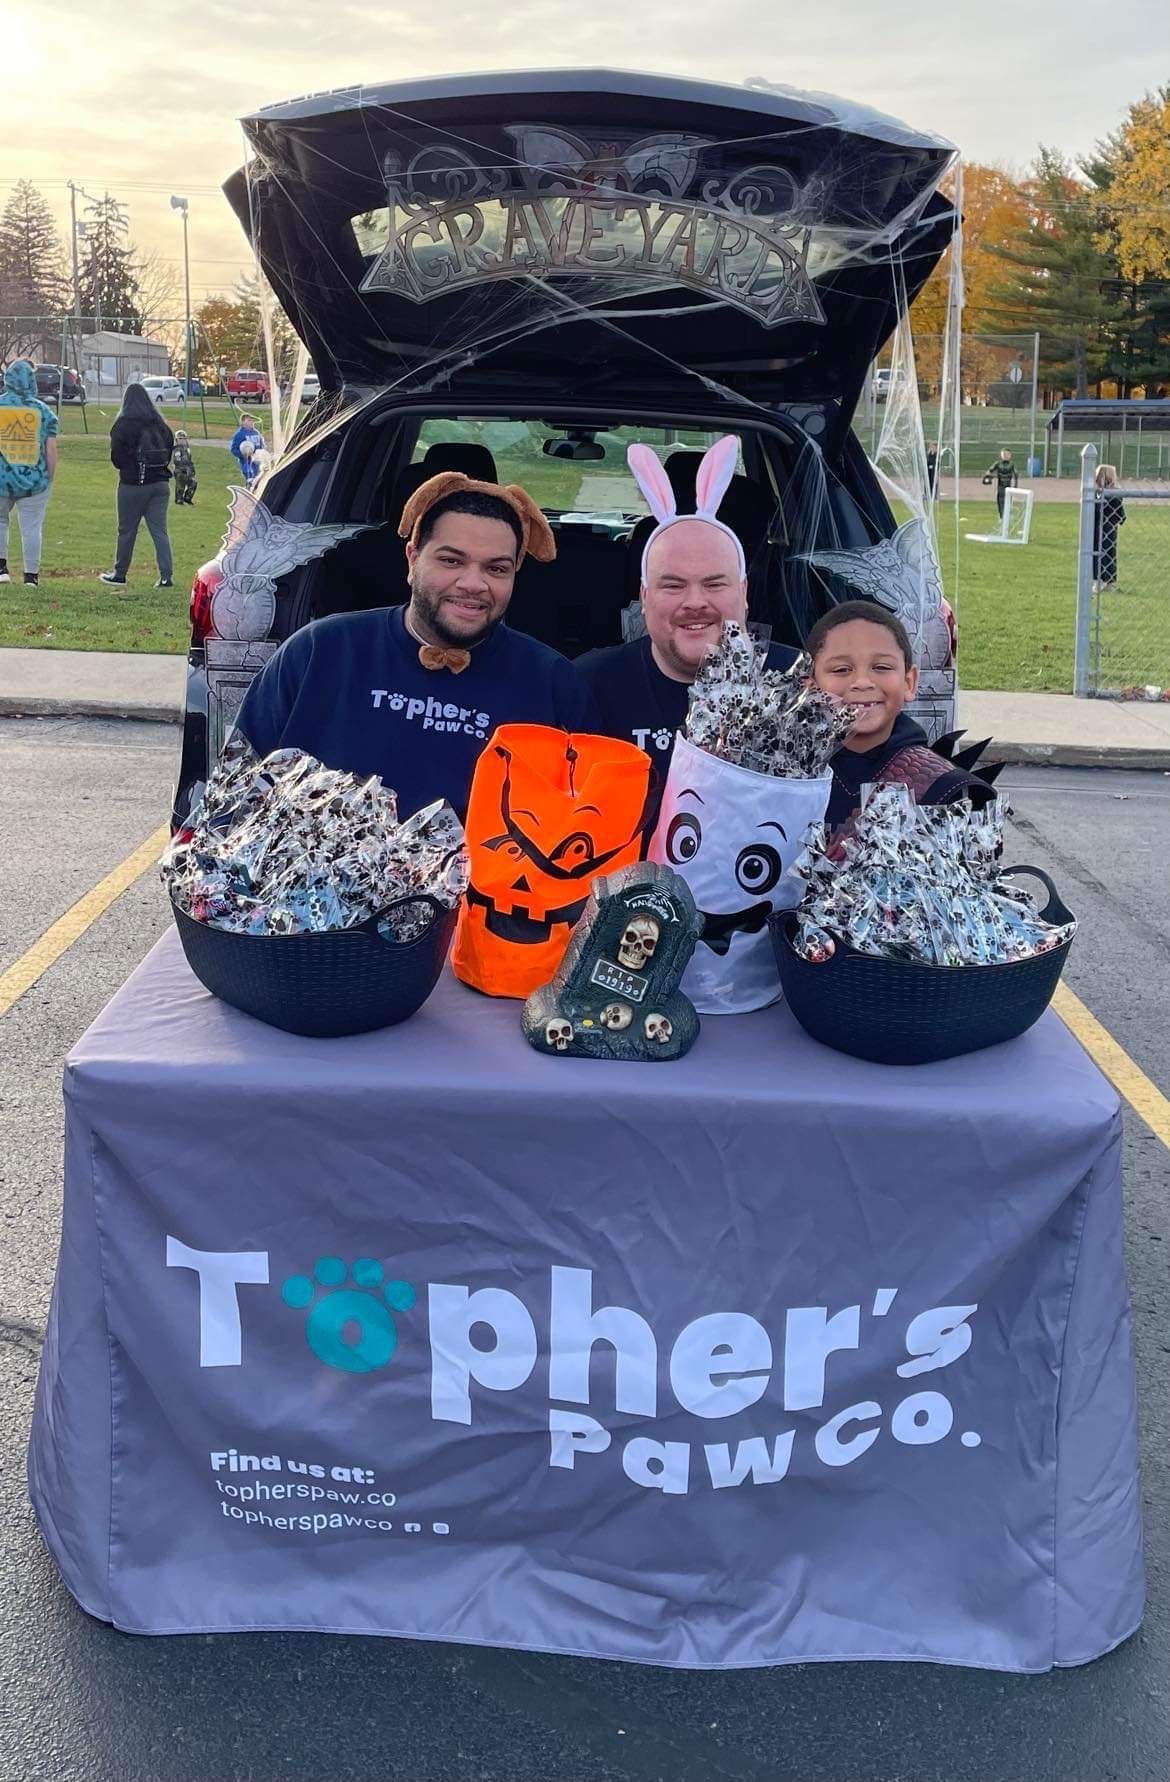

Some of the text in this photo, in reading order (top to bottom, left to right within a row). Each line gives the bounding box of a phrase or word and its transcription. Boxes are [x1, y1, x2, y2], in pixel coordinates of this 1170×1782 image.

[404, 196, 795, 305] GRAVEYARD
[371, 690, 490, 728] Topher's
[166, 1235, 977, 1425] Topher's
[210, 1449, 375, 1484] Find us at:
[216, 1480, 396, 1506] topherspaw.co
[221, 1501, 392, 1534] topherspawco
